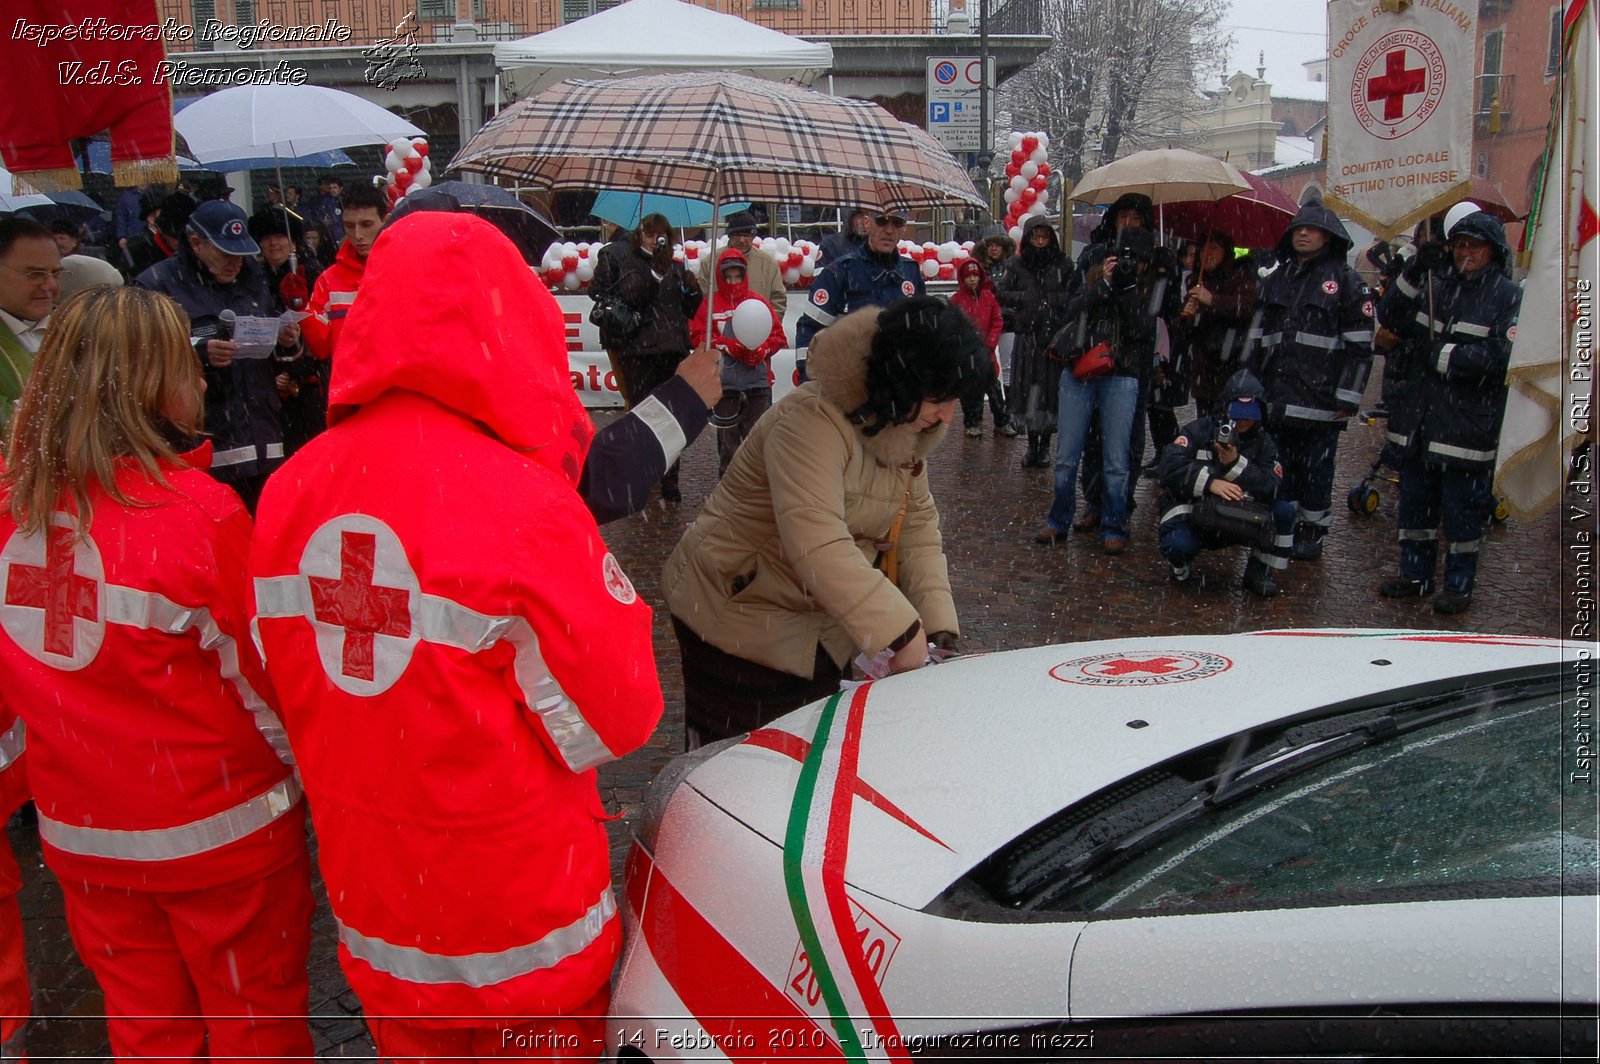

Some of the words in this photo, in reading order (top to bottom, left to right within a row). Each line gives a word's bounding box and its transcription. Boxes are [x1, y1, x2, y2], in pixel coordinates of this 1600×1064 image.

[1333, 15, 1368, 59] CROCE
[1379, 33, 1420, 51] GINEVRA
[1420, 39, 1431, 53] 22
[1370, 48, 1379, 60] DI
[1428, 50, 1443, 96] AGOSTO
[1353, 56, 1374, 128] CONVENZIONE
[934, 105, 946, 120] P
[1416, 97, 1436, 121] 1864
[1342, 160, 1395, 176] COMITATO
[1398, 150, 1449, 168] LOCALE
[1333, 180, 1384, 197] SETTIMO
[1388, 169, 1459, 189] TORINESE
